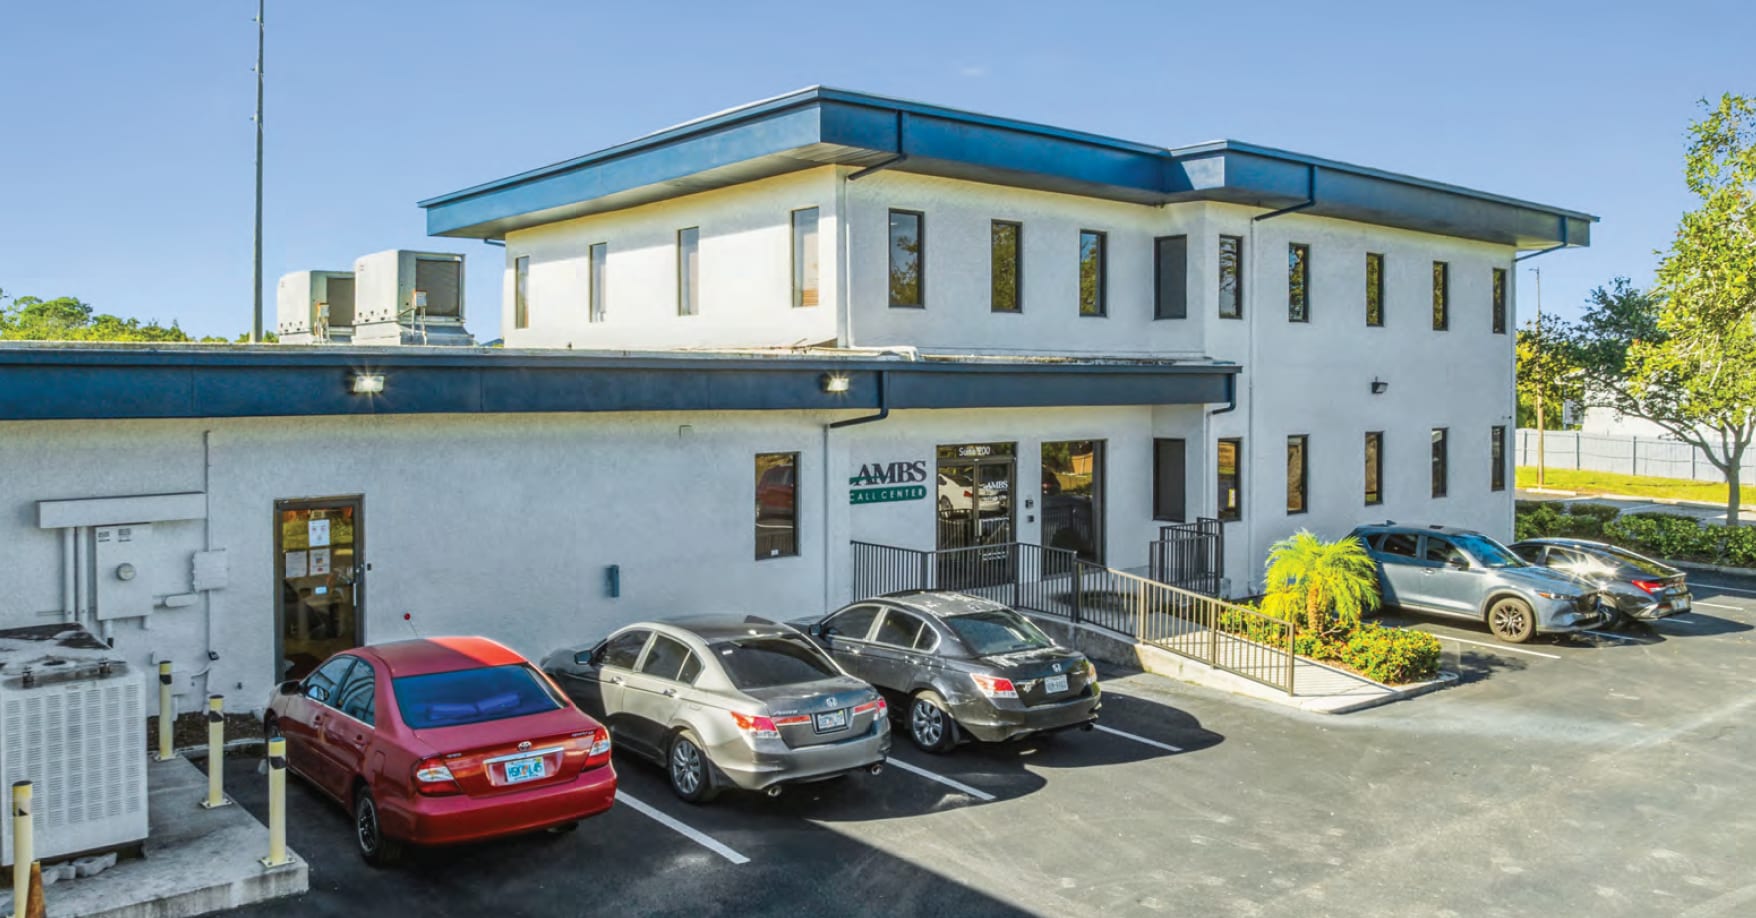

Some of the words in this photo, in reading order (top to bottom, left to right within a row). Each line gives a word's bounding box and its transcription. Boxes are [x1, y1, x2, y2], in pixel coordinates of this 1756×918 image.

[853, 460, 927, 486] AMBS
[985, 480, 1008, 490] AMBS
[881, 488, 923, 500] CENTER
